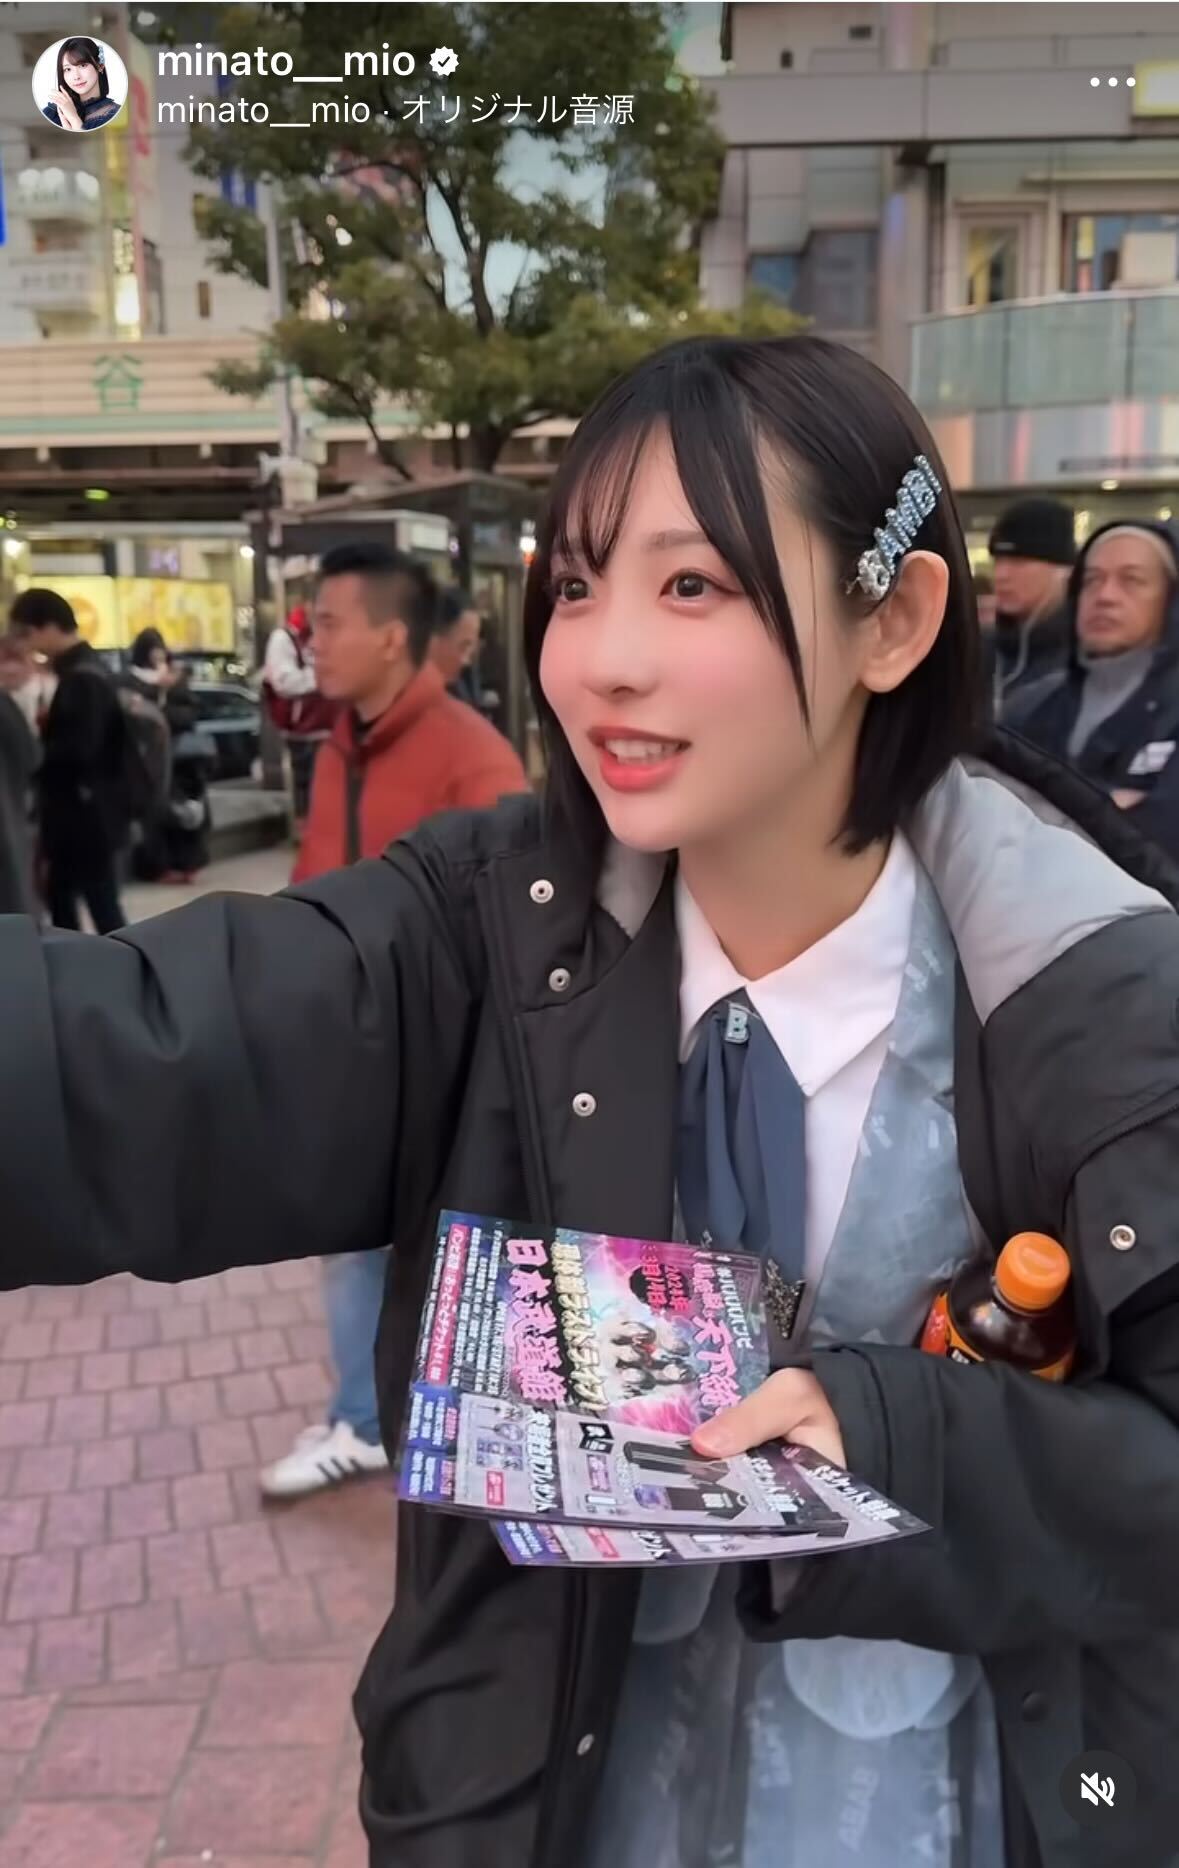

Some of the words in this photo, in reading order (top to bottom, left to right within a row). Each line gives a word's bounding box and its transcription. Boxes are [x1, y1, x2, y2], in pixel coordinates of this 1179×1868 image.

[724, 1004, 750, 1043] B
[506, 1239, 568, 1404] 日本武道館
